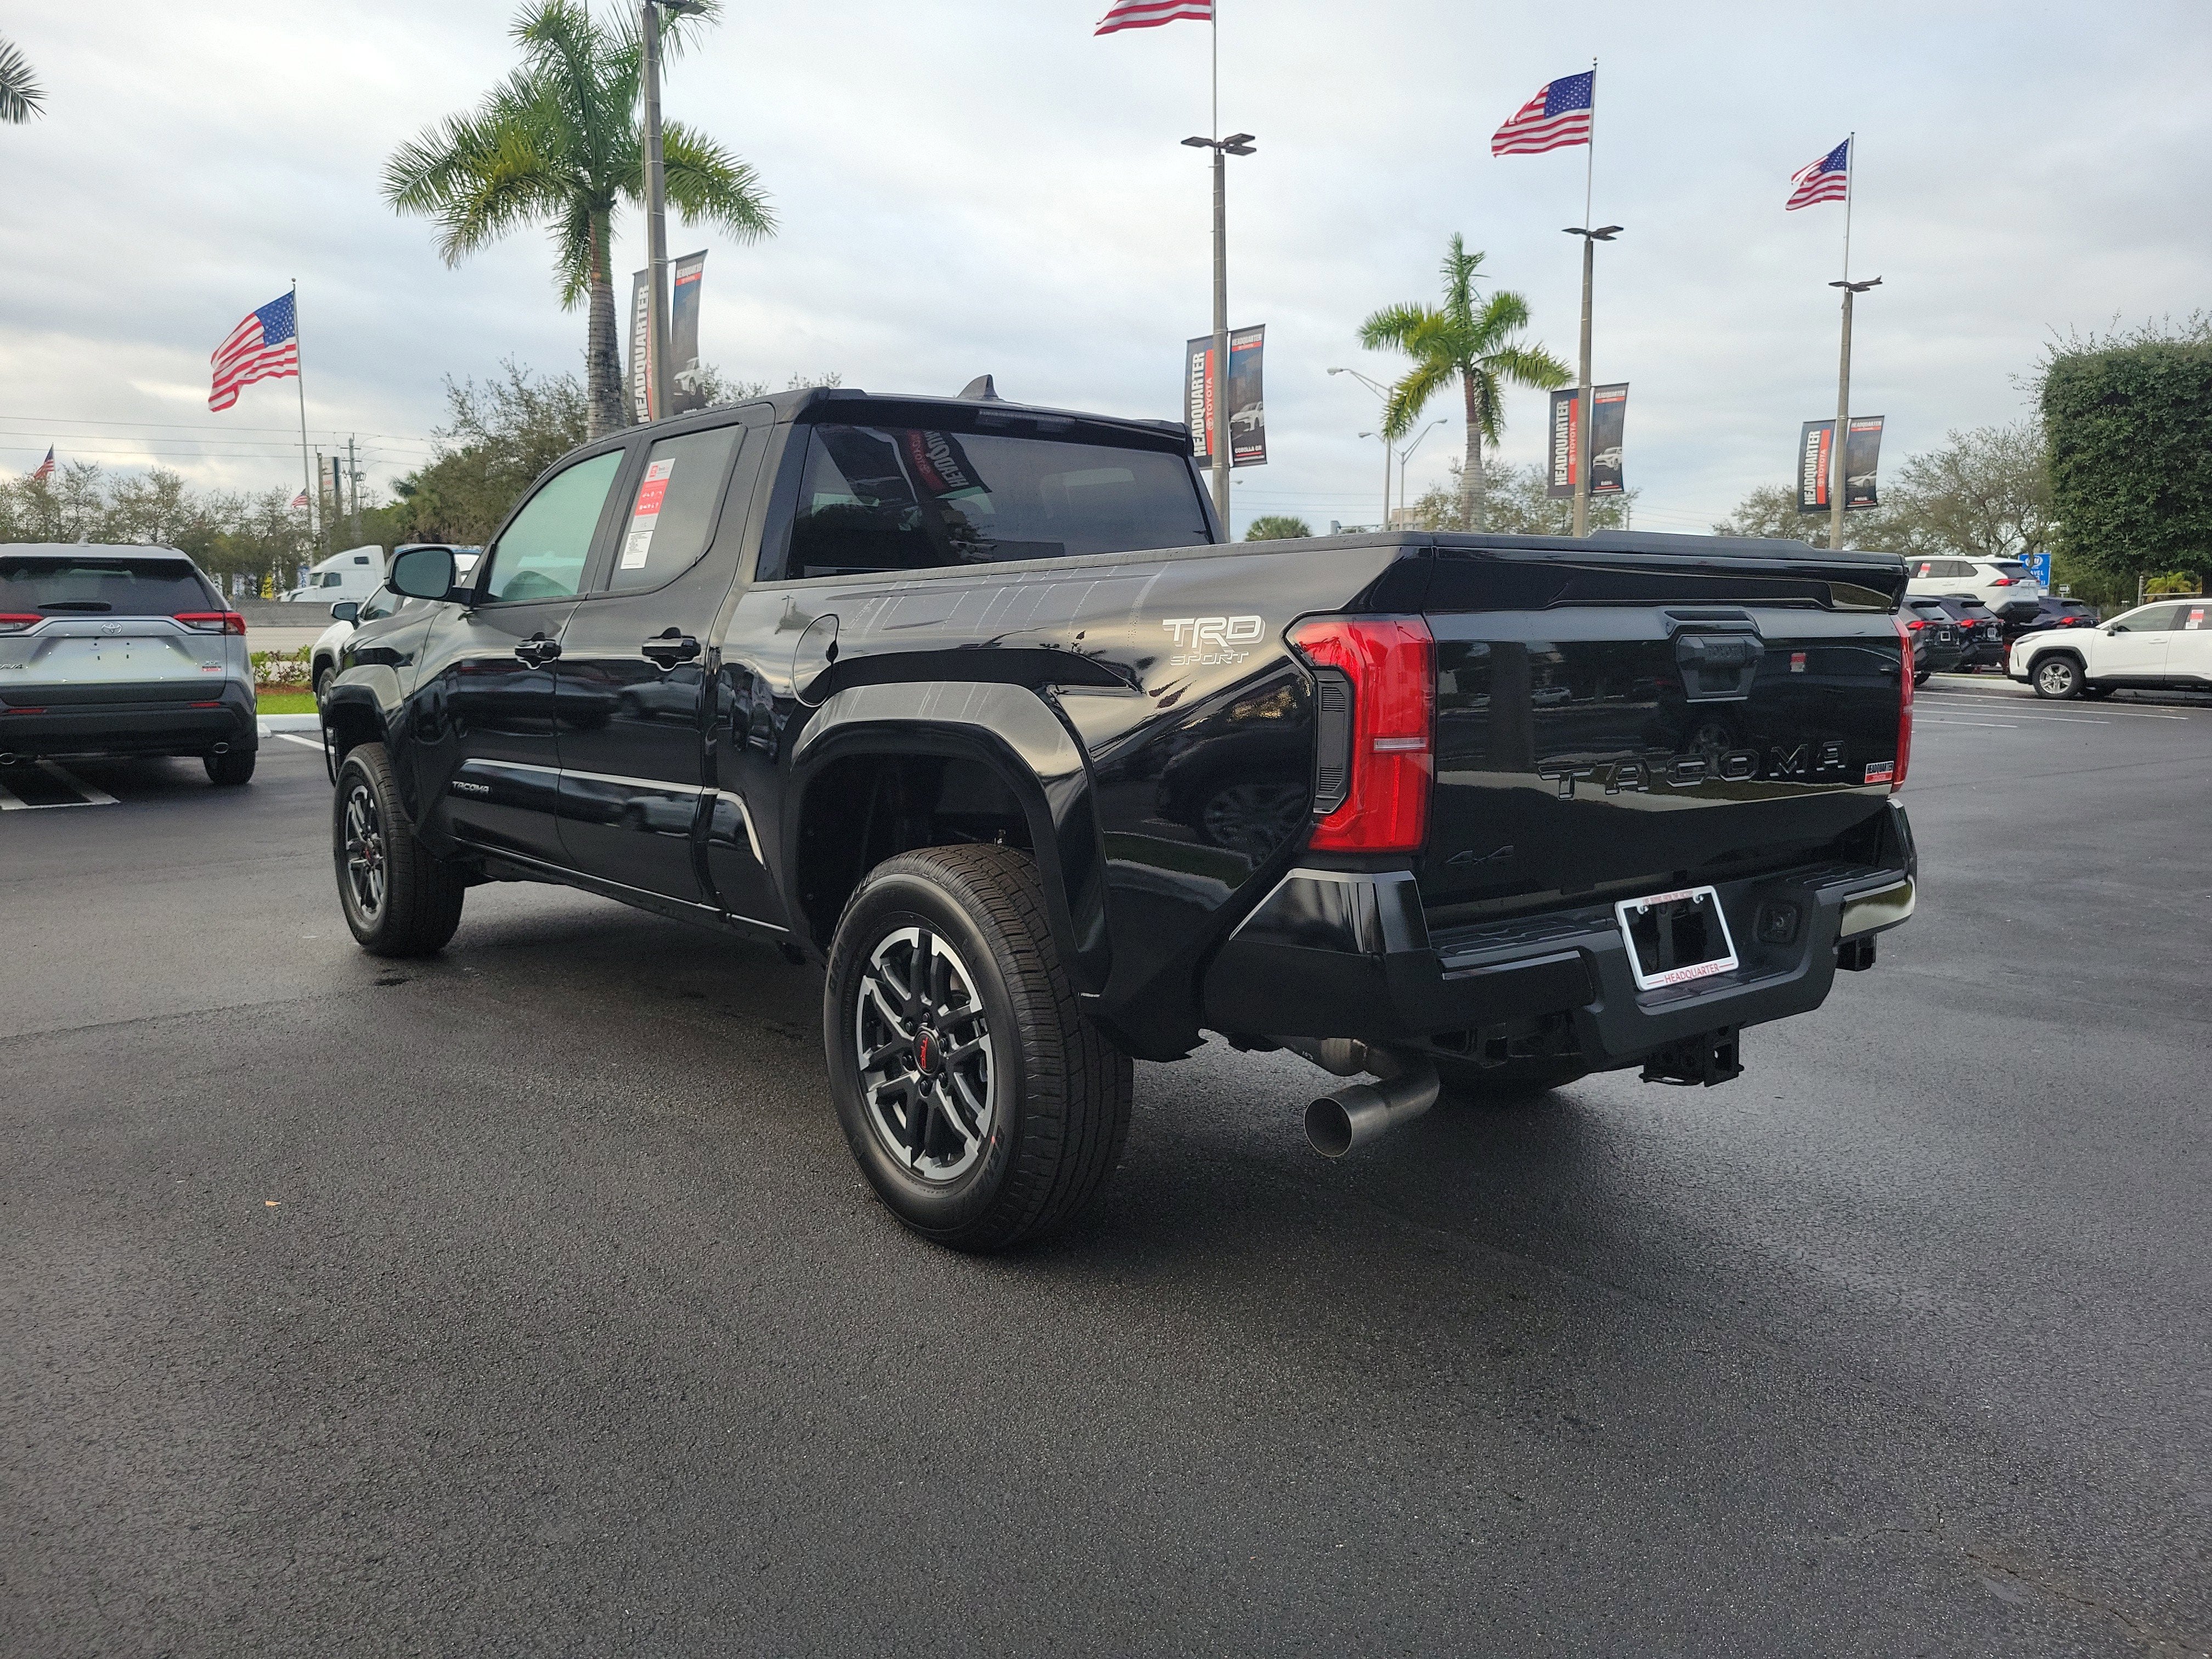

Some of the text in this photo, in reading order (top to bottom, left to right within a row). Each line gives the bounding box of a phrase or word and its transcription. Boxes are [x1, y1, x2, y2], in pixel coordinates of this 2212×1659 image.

[634, 285, 650, 423] HEADQUARTER
[1190, 351, 1207, 457] HEADQUARTER
[1555, 400, 1570, 486] HEADQUARTER
[1804, 430, 1821, 505] HEADQUARTER
[1163, 615, 1266, 653] TRD
[1170, 652, 1249, 665] SPORT
[452, 781, 489, 793] TACOMA
[1537, 741, 1846, 800] TACOMA
[1664, 963, 1720, 984] HEADQUARTER
